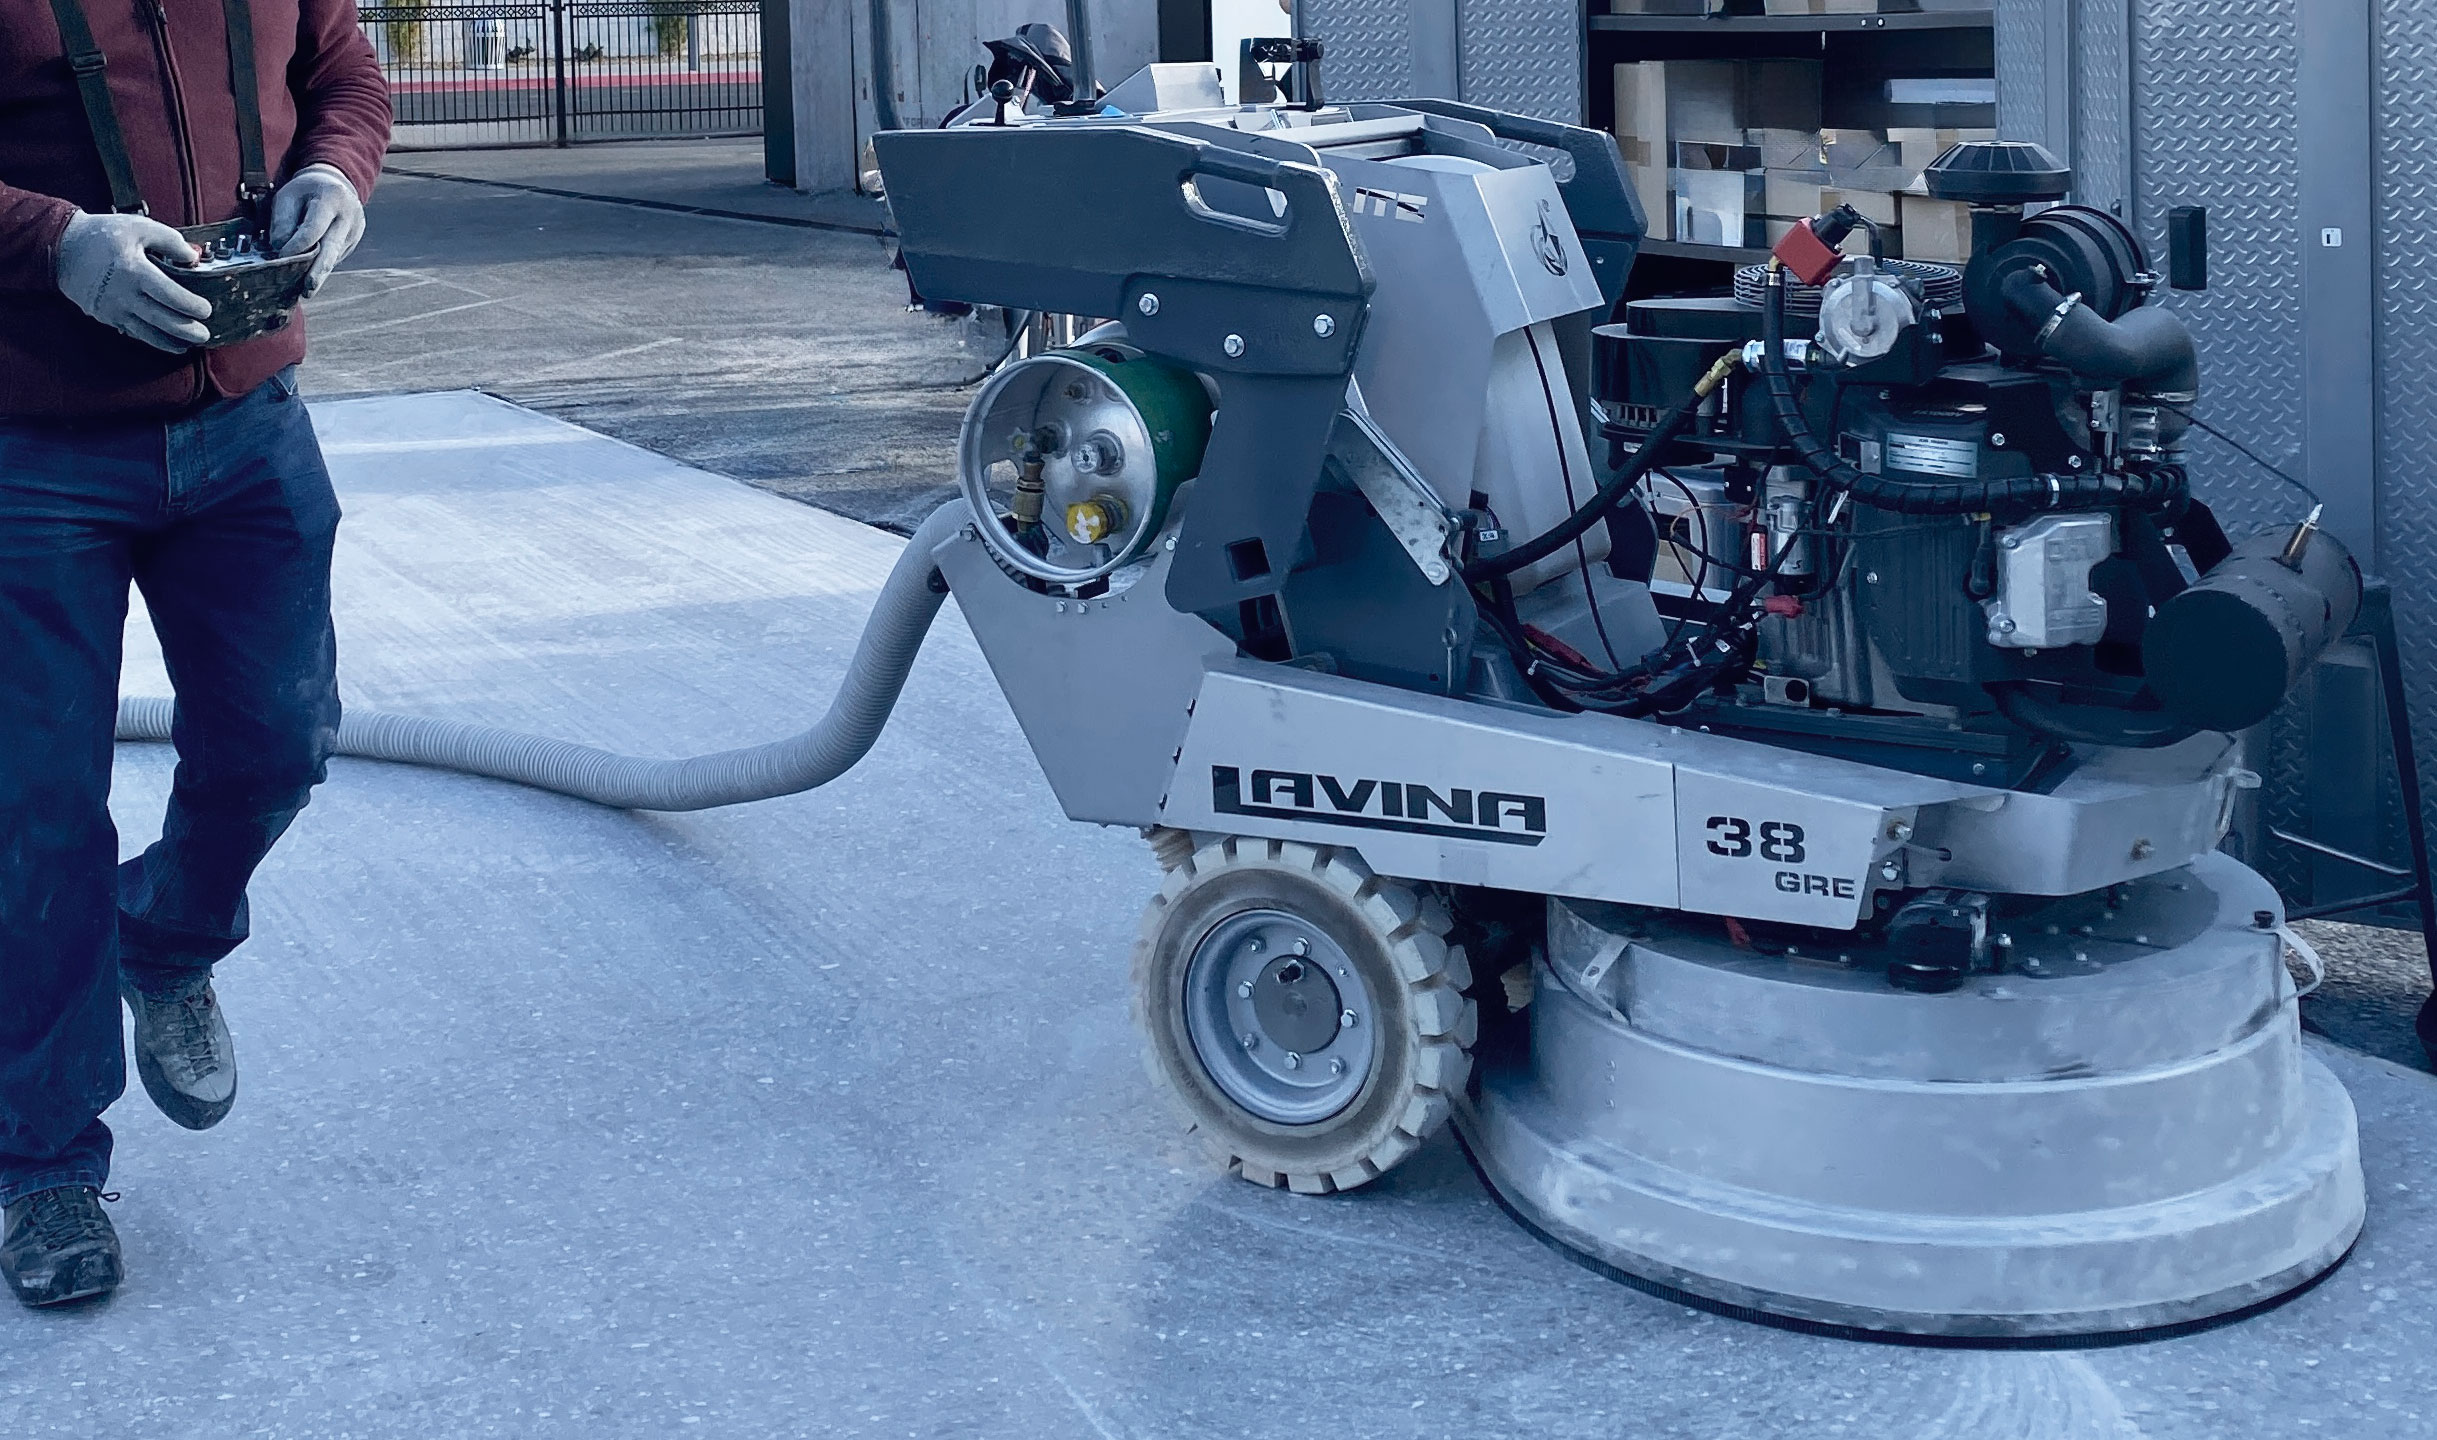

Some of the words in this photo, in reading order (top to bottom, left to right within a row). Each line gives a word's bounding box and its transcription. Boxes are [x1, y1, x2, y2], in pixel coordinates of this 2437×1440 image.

[1353, 186, 1428, 224] ITE
[1212, 765, 1547, 846] LAVINA
[1706, 816, 1806, 864] 38
[1775, 871, 1855, 900] GRE
